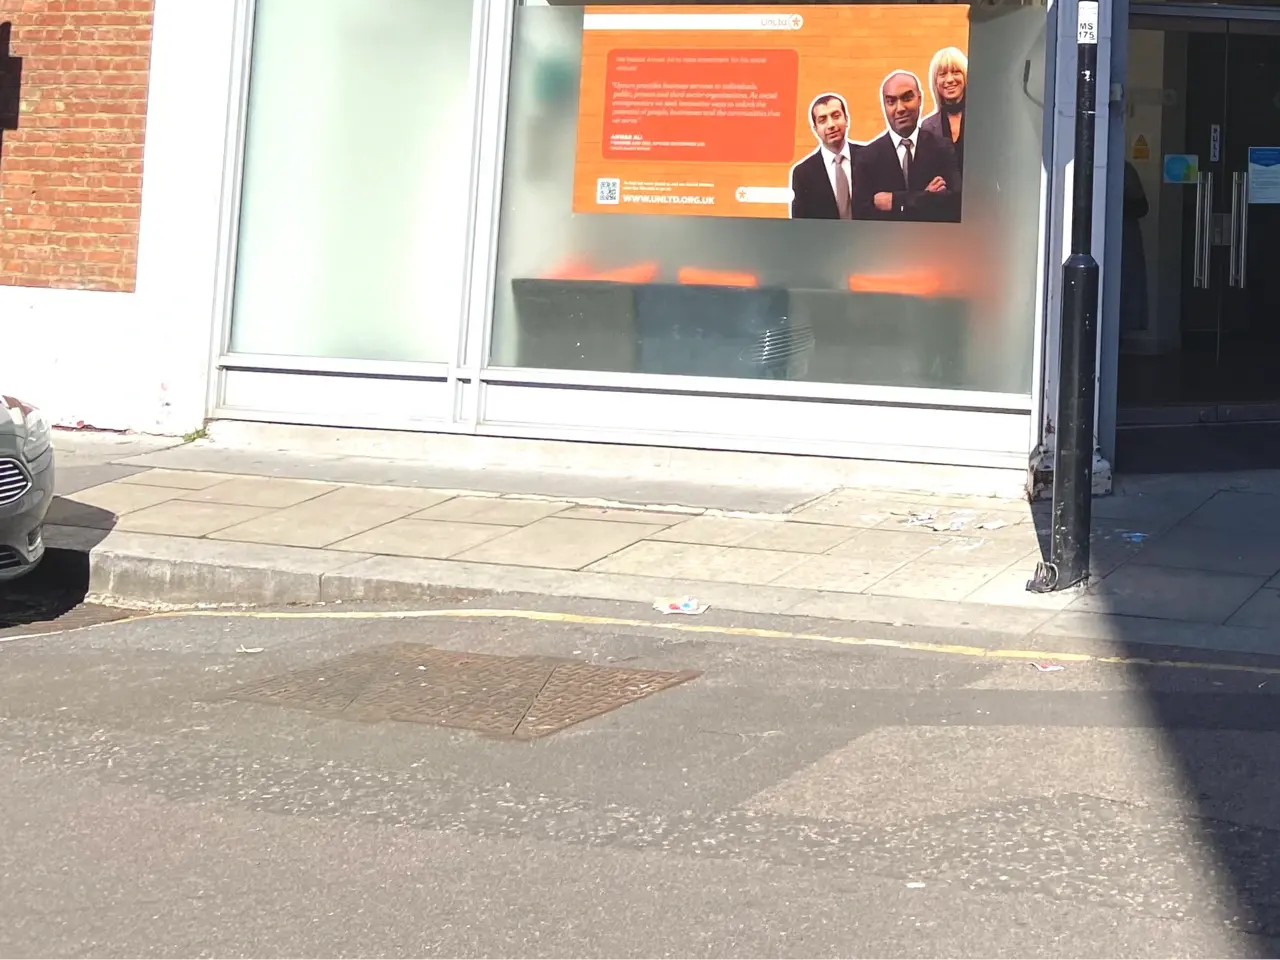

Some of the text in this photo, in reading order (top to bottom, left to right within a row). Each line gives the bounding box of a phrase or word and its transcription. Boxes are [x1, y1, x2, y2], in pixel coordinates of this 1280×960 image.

[1079, 22, 1094, 31] MS
[1078, 31, 1095, 39] 175
[622, 193, 715, 205] WWW.UNLTD.ORG.UK
